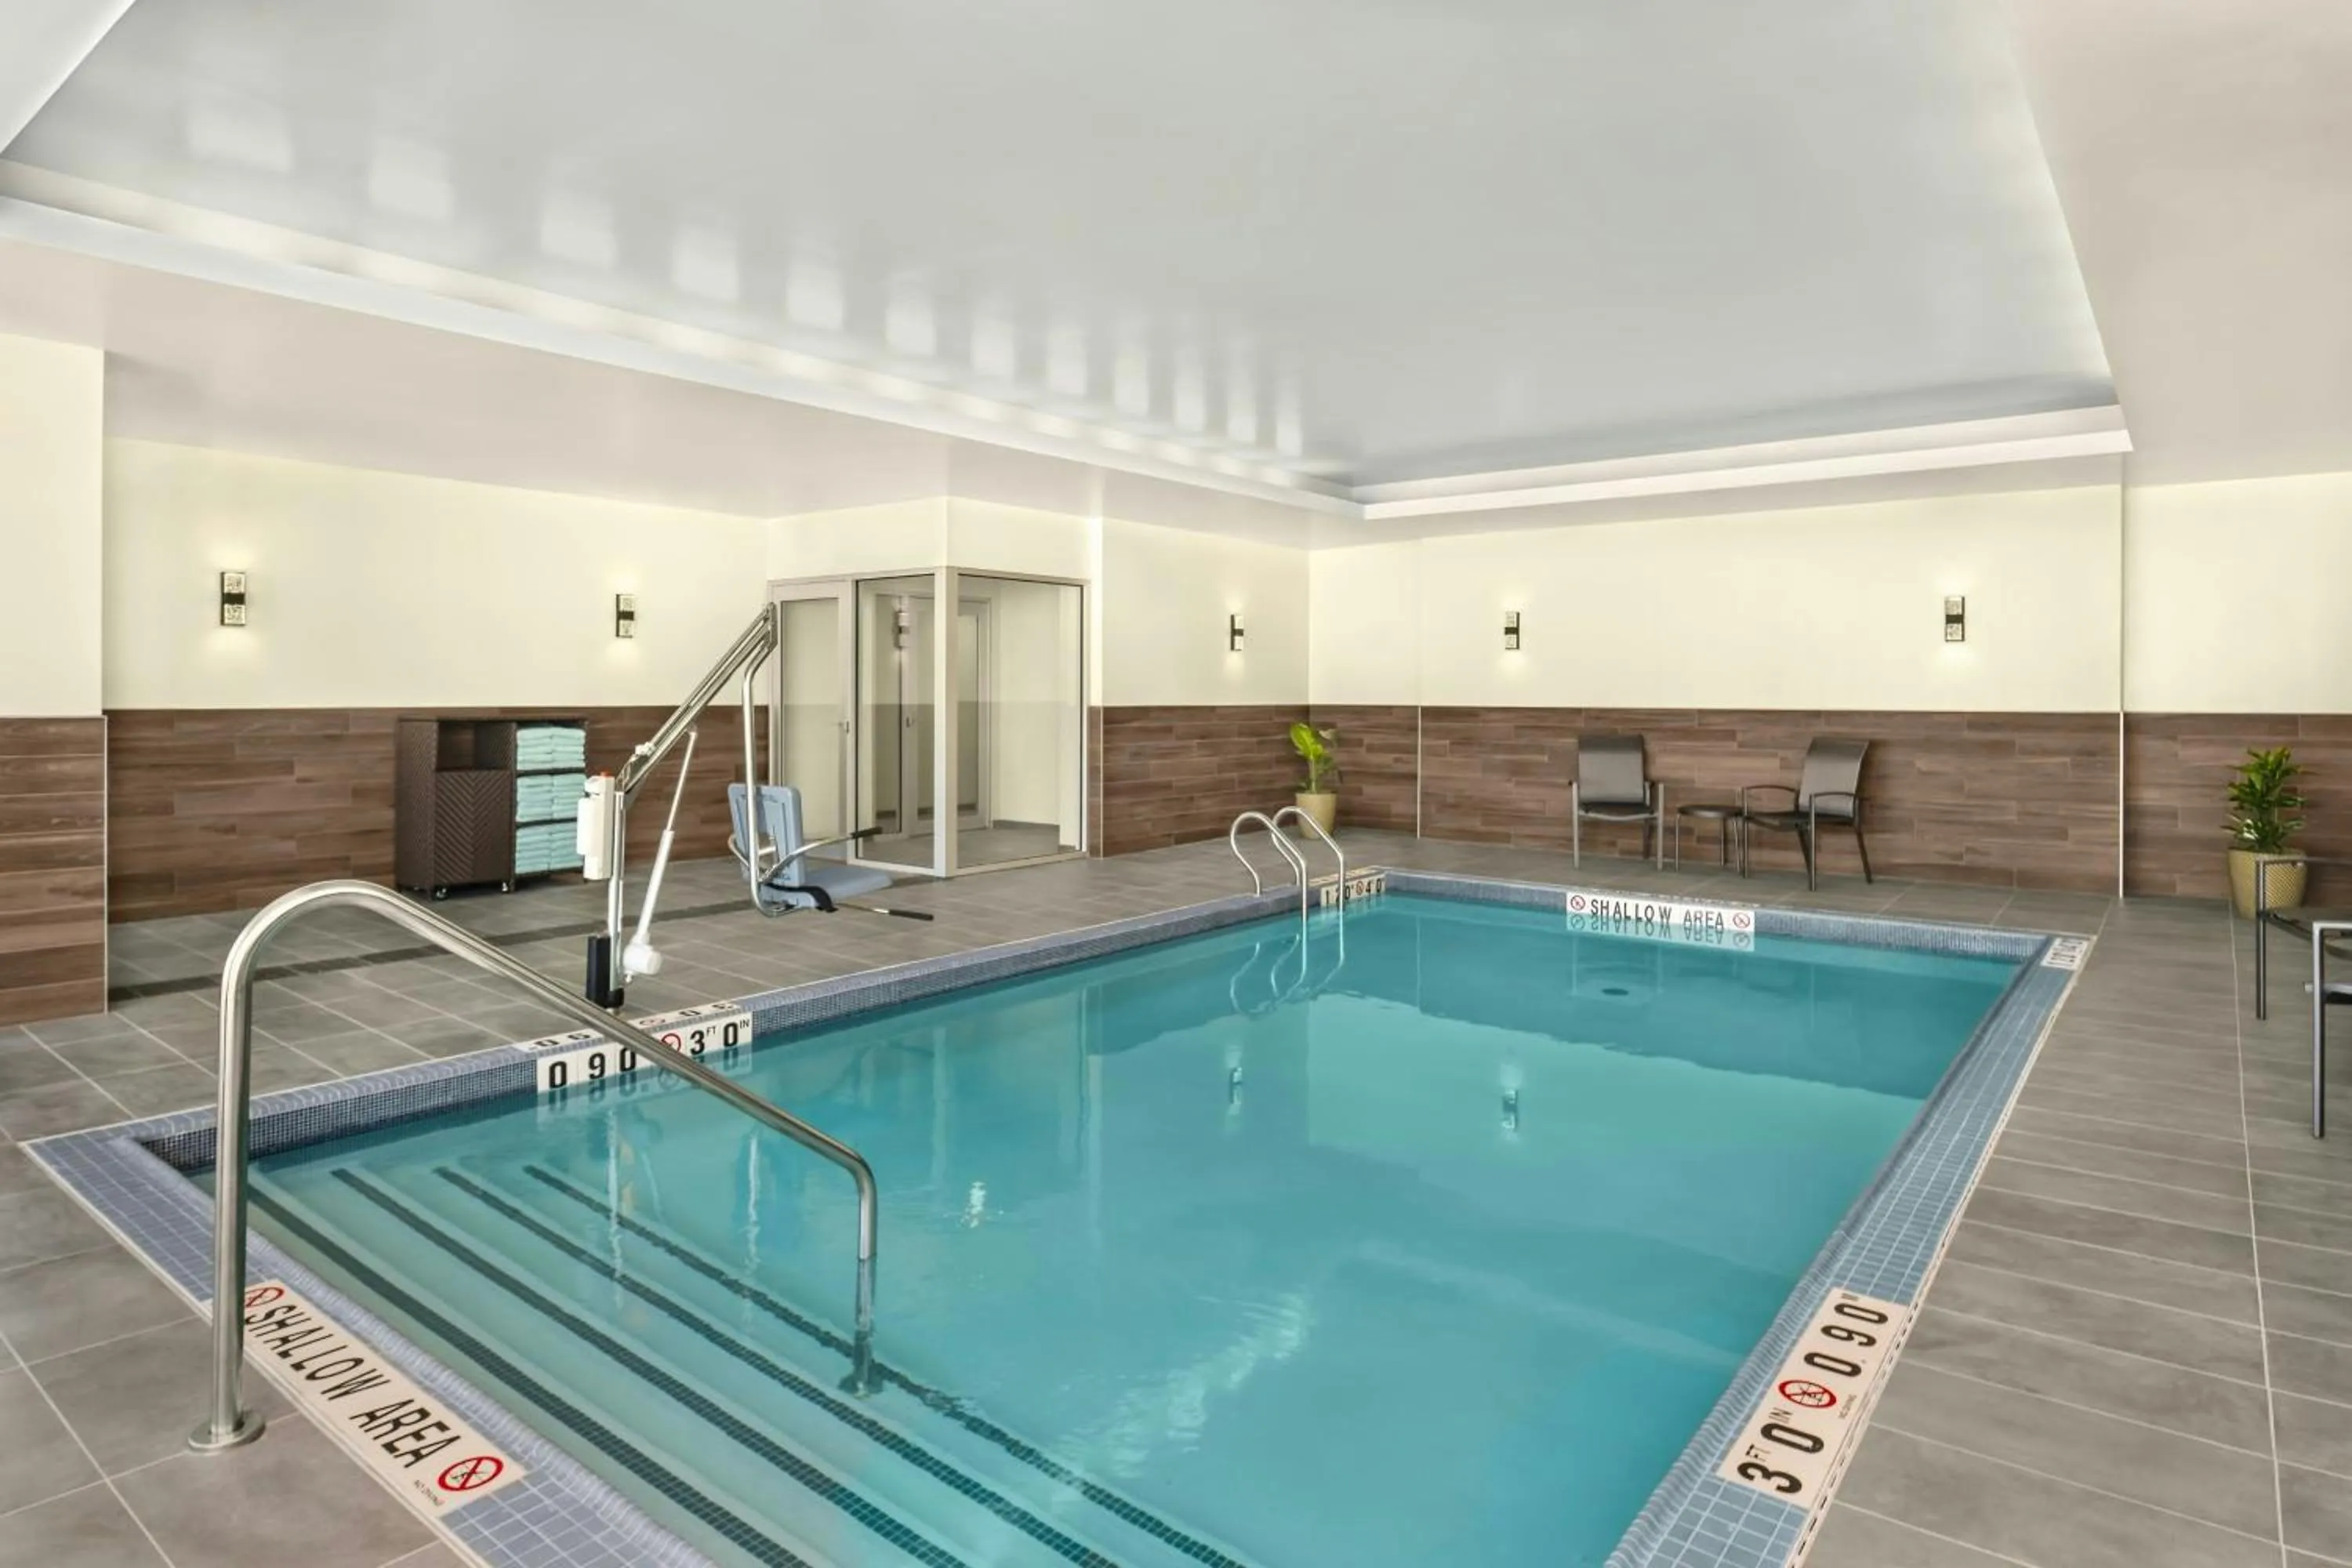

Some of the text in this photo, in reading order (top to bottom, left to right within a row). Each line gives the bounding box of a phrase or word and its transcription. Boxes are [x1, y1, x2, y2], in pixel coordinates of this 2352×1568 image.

[1591, 899, 1724, 931] SHALLOW AREA
[245, 1305, 462, 1468] SHALLOW AREA
